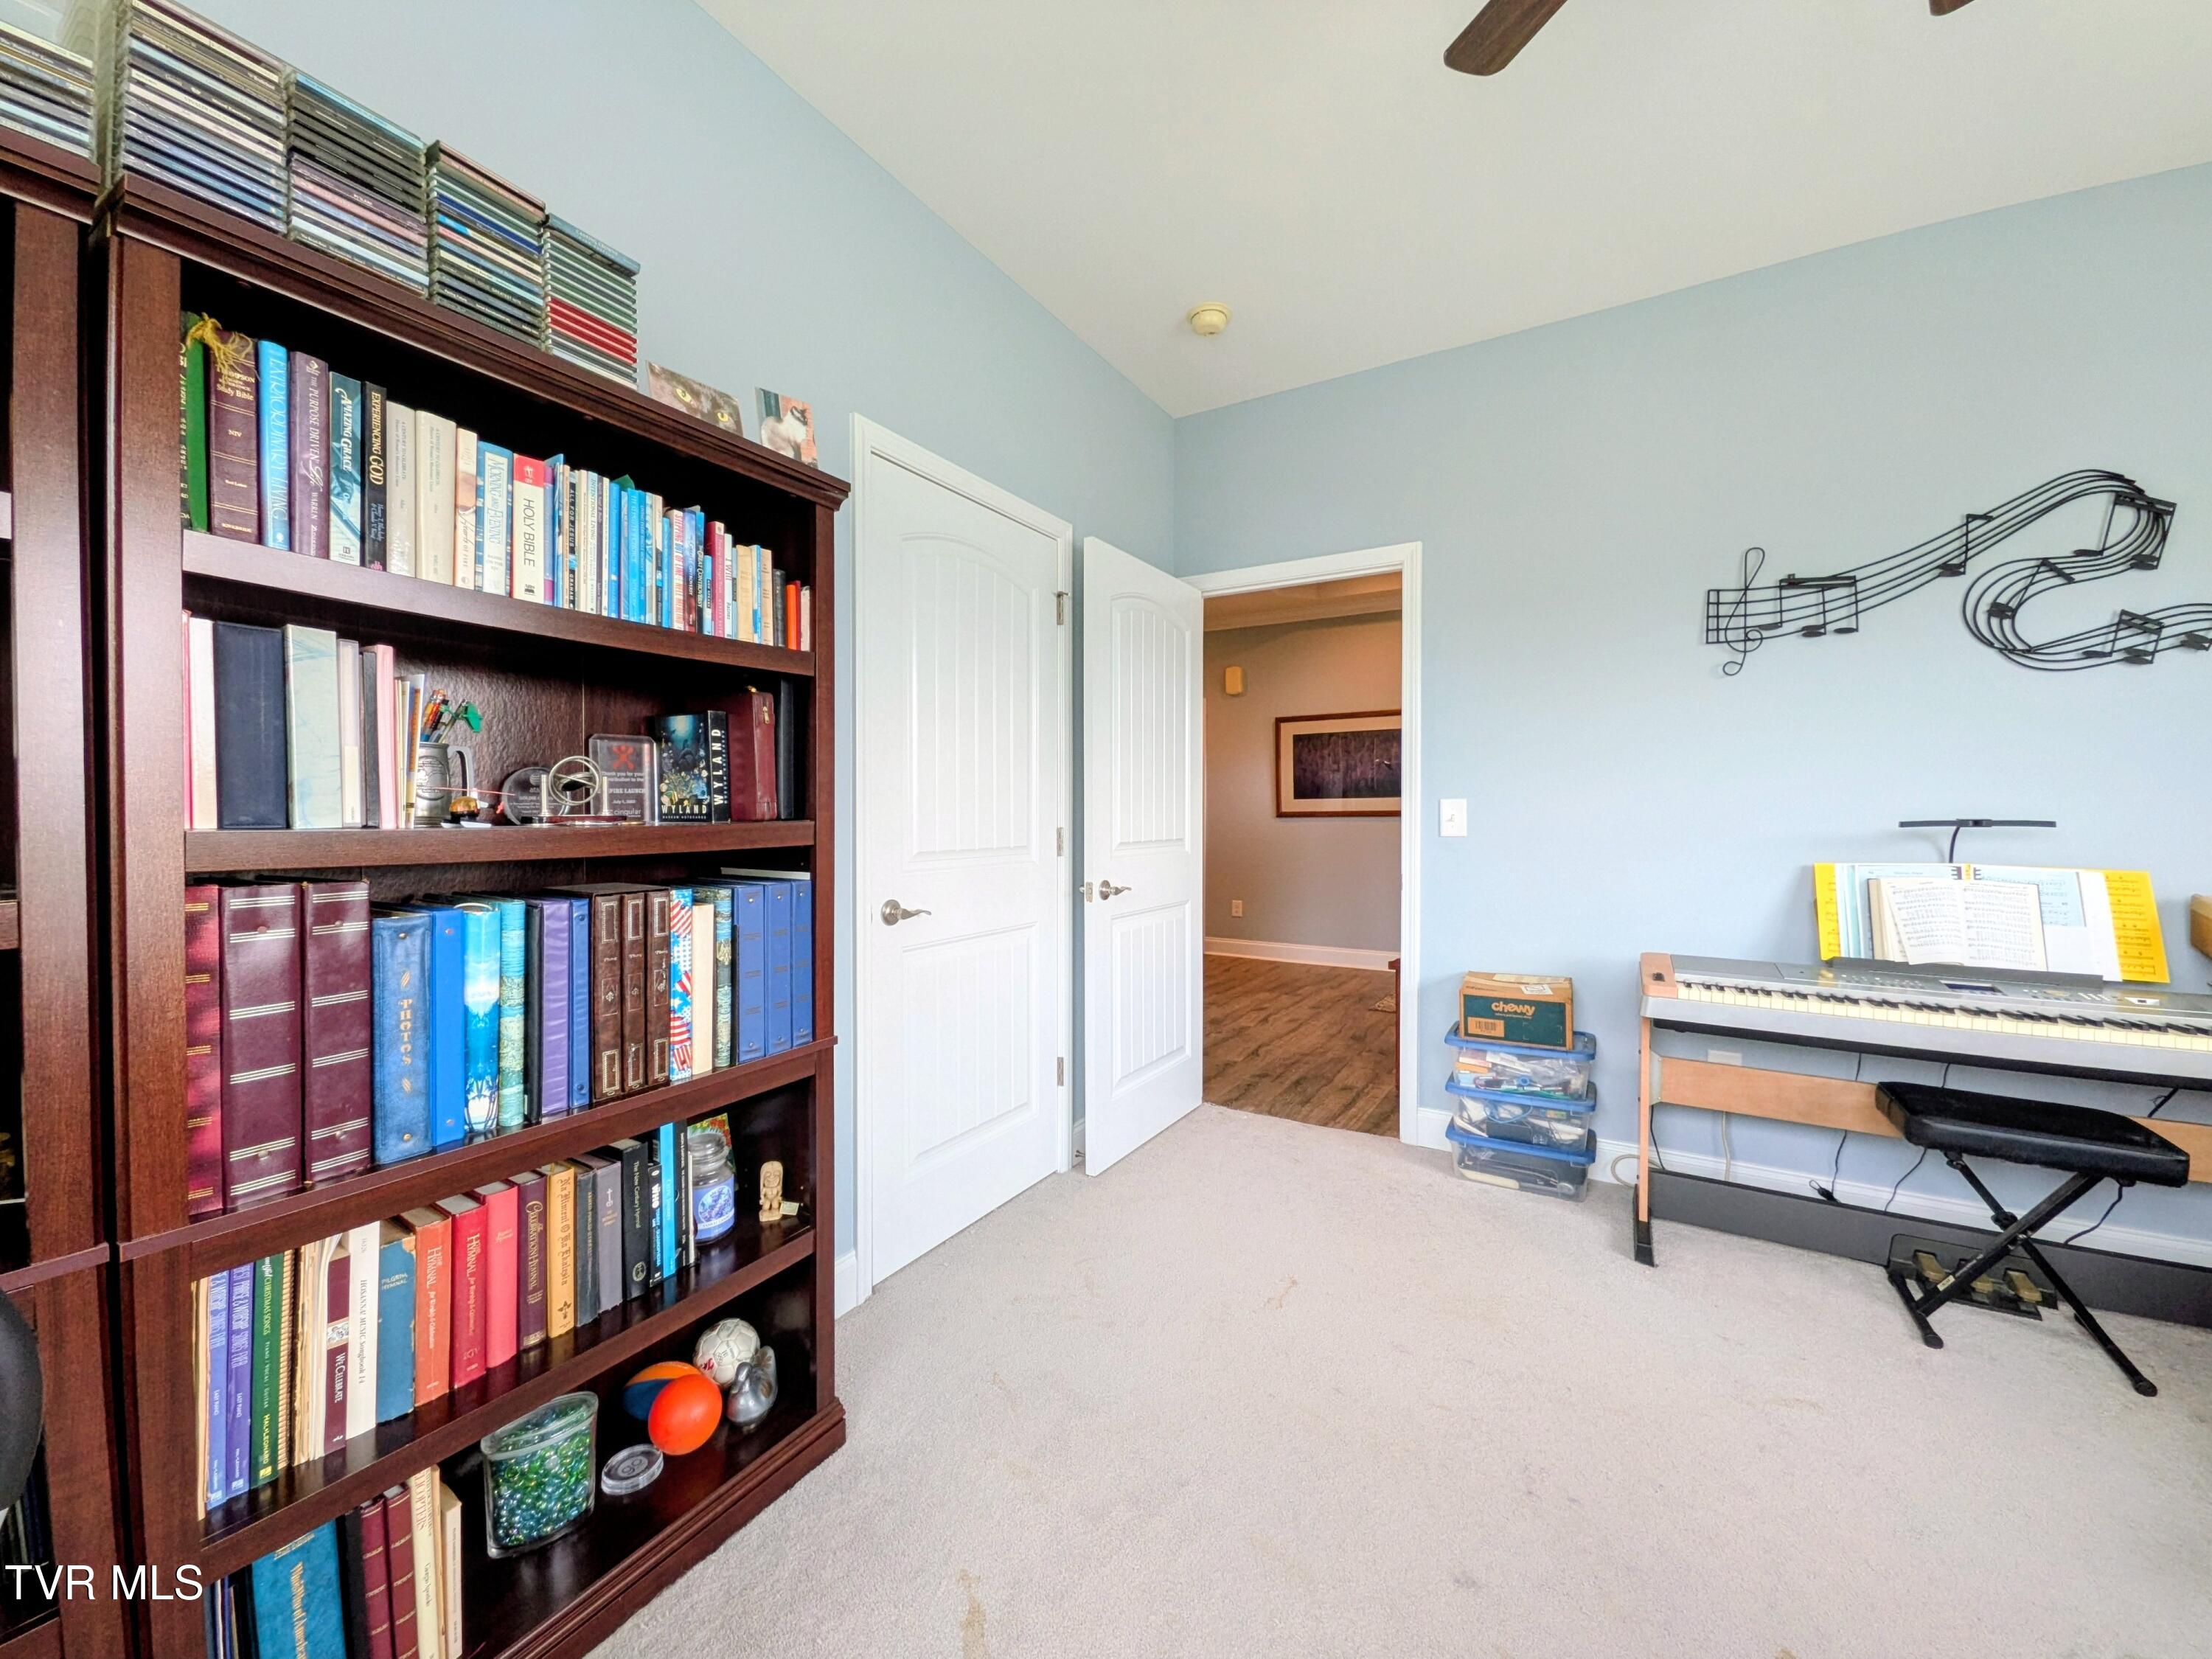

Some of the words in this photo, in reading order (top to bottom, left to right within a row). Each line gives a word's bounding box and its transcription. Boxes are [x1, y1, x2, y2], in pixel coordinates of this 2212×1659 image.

[309, 387, 319, 425] PURPOSE
[335, 387, 352, 437] AMAZING
[229, 429, 242, 437] NIV
[371, 392, 381, 455] EXPERIENCING
[310, 428, 319, 462] DRIVEN
[341, 438, 352, 472] GRACE
[369, 456, 384, 485] GOD
[488, 458, 505, 497] MORNING
[271, 478, 288, 521] LIVING
[487, 508, 507, 544] EVENING
[524, 498, 535, 531] HOLY
[675, 514, 684, 543] STEPPING
[524, 532, 535, 567] BIBLE
[675, 543, 684, 553] OUT
[675, 563, 684, 575] LINE
[712, 729, 724, 805] WYLAND
[661, 805, 707, 813] WYLAND
[1492, 1001, 1535, 1016] chewy
[398, 999, 413, 1065] PHOTOS
[652, 1183, 661, 1208] WHO
[526, 1201, 543, 1254] CELEBRATION
[427, 1246, 442, 1289] HYMNAL
[467, 1234, 480, 1276] HYMNAL
[381, 1273, 408, 1285] PILGRIM
[381, 1279, 408, 1290] HYMNAL
[528, 1254, 539, 1290] HYMNAL
[210, 1286, 226, 1310] WORSHIP
[232, 1280, 250, 1300] PRAISE
[264, 1277, 272, 1313] CHRISTMAS
[467, 1284, 476, 1304] Worship
[209, 1312, 226, 1333] SONGS
[232, 1304, 249, 1329] WORSHIP
[428, 1298, 436, 1318] Worship
[263, 1313, 271, 1335] SONGS
[359, 1317, 367, 1340] MUSIC
[209, 1332, 226, 1349] EVER
[232, 1331, 248, 1352] SONGS
[231, 1352, 248, 1368] EVER
[358, 1341, 366, 1375] Songbook
[334, 1366, 346, 1403] CELEBRATE
